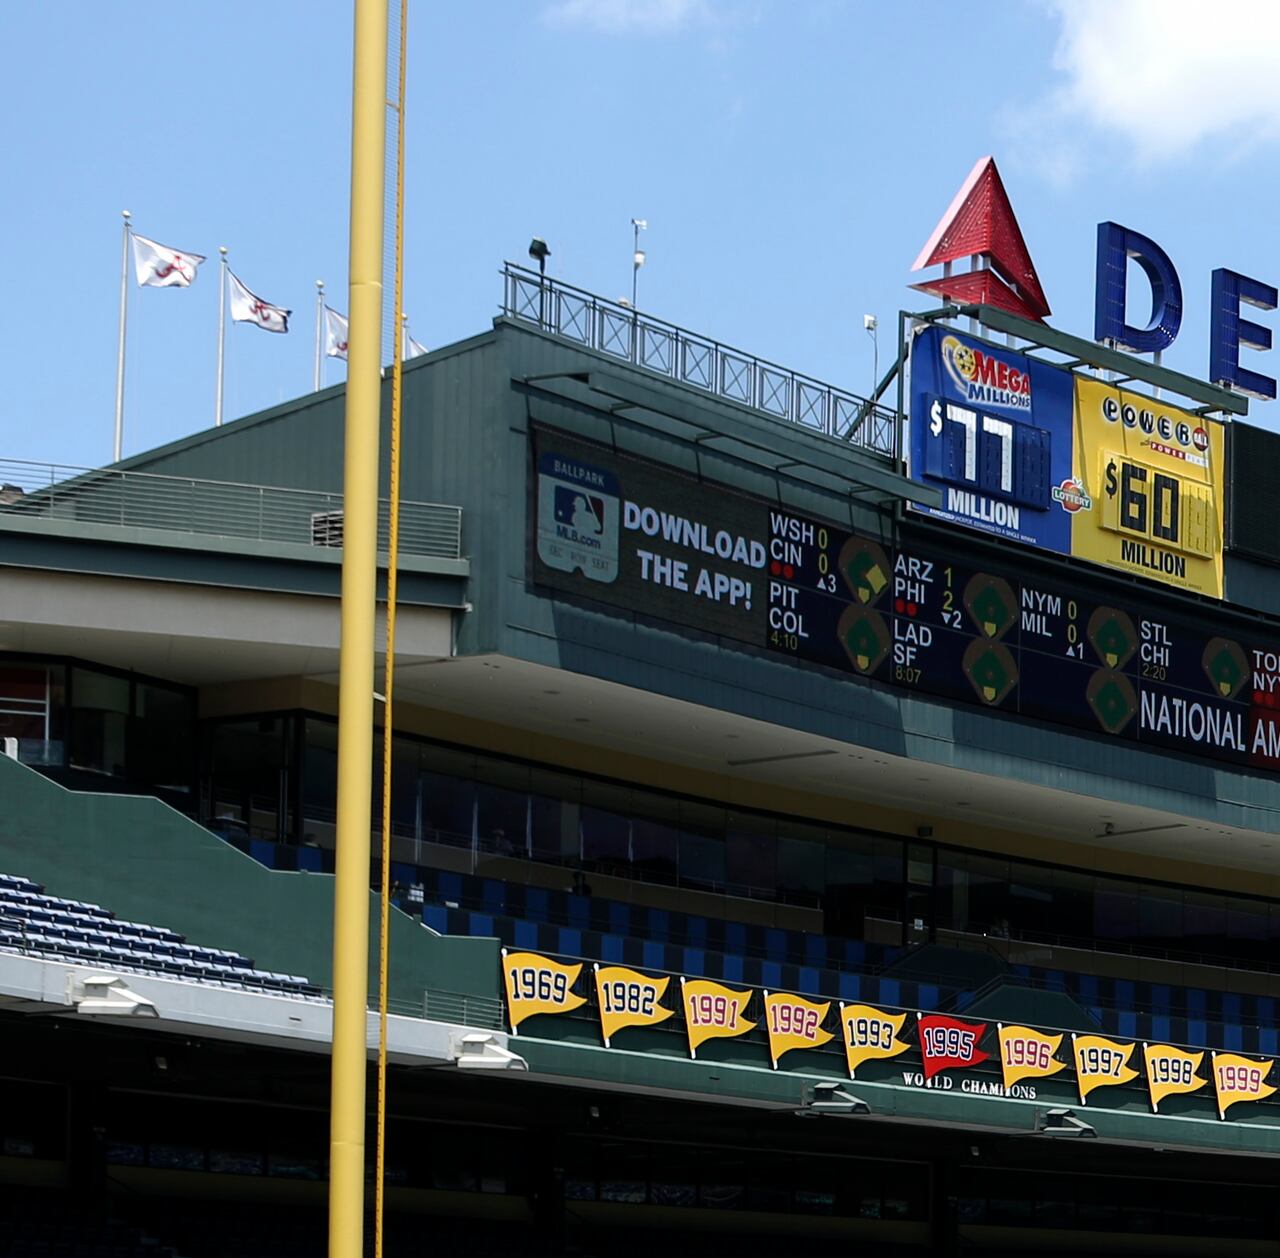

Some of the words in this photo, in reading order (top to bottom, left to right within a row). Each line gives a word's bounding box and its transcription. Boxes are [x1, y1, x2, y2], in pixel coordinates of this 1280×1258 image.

[972, 351, 1031, 394] MEGA
[968, 383, 1031, 409] MILLIONS
[554, 459, 605, 488] BALLPARK
[948, 488, 1019, 530] MILLION
[1053, 489, 1091, 508] LOTTERY
[556, 525, 600, 549] MLB.com
[624, 500, 766, 569] DOWNLOAD
[771, 512, 814, 546] WSH
[818, 528, 827, 549] 0
[770, 538, 802, 567] CIN
[818, 553, 828, 575] 0
[895, 554, 933, 583] ARZ
[944, 567, 952, 587] 1
[1121, 539, 1186, 579] MILLION
[637, 549, 688, 592] THE
[694, 568, 752, 611] APP!
[770, 582, 799, 609] PIT
[828, 575, 837, 593] 3
[895, 576, 925, 604] PHI
[943, 590, 953, 611] 2
[1022, 587, 1061, 616] NYM
[1068, 600, 1077, 620] 0
[769, 607, 809, 638] COL
[894, 619, 932, 647] LAD
[953, 611, 962, 629] 2
[1021, 610, 1052, 637] MIL
[1067, 624, 1077, 644] 0
[1141, 620, 1172, 646] STL
[770, 630, 798, 650] 4:10
[894, 643, 917, 666] SF
[1141, 643, 1169, 667] CHI
[895, 665, 921, 684] 8:07
[1142, 662, 1166, 681] 2:20
[1140, 690, 1246, 752] NATIONAL
[510, 968, 567, 1004] 1969
[602, 981, 656, 1016] 1982
[688, 994, 739, 1029] 1991
[770, 1004, 819, 1039] 1992
[847, 1018, 895, 1051] 1993
[923, 1026, 976, 1061] 1995
[1005, 1038, 1052, 1069] 1996
[1079, 1047, 1125, 1077] 1997
[902, 1072, 953, 1090] WOLD
[1150, 1056, 1193, 1085] 1998
[1218, 1066, 1262, 1093] 1999
